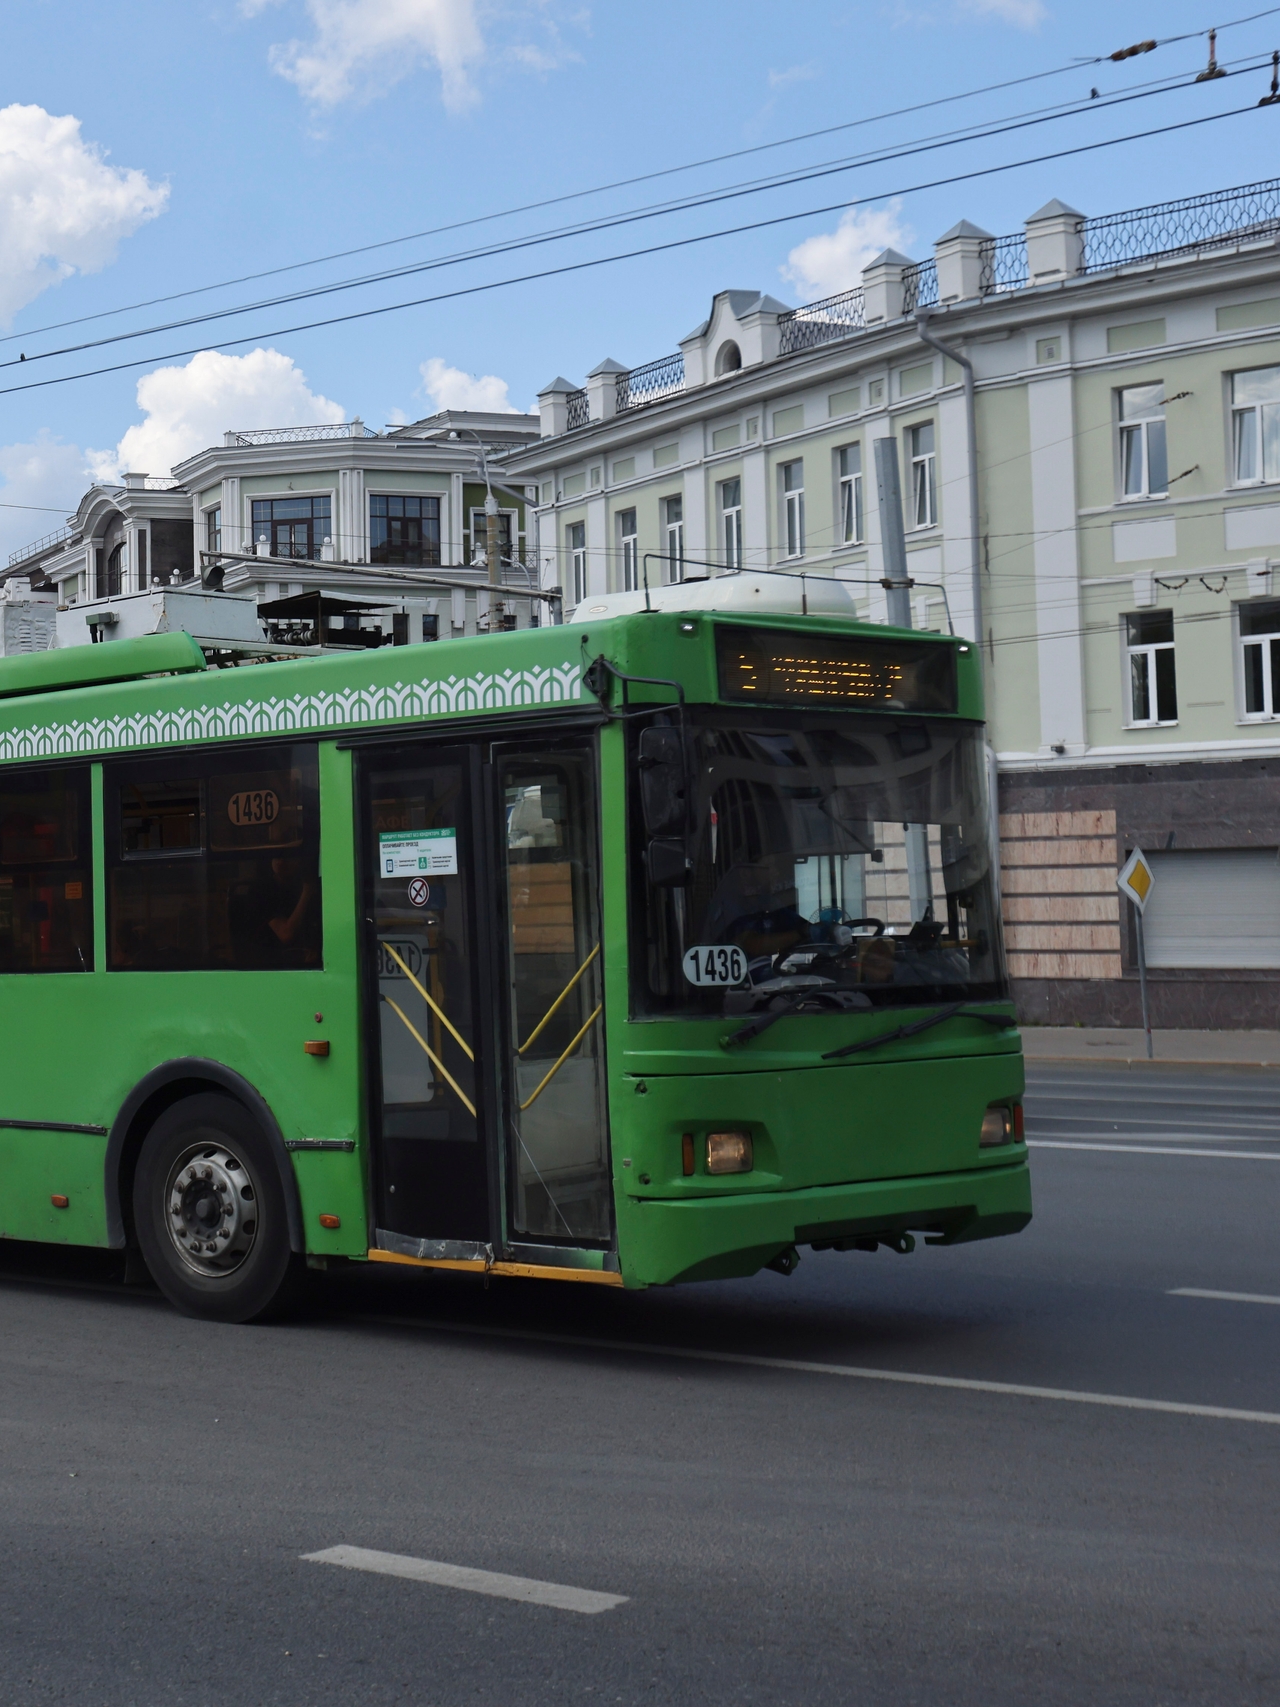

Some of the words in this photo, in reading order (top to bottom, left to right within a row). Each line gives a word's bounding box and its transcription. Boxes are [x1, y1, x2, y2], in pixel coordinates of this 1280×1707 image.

[232, 791, 274, 823] 1436
[373, 814, 411, 830] АФЕ
[689, 948, 742, 983] 1436
